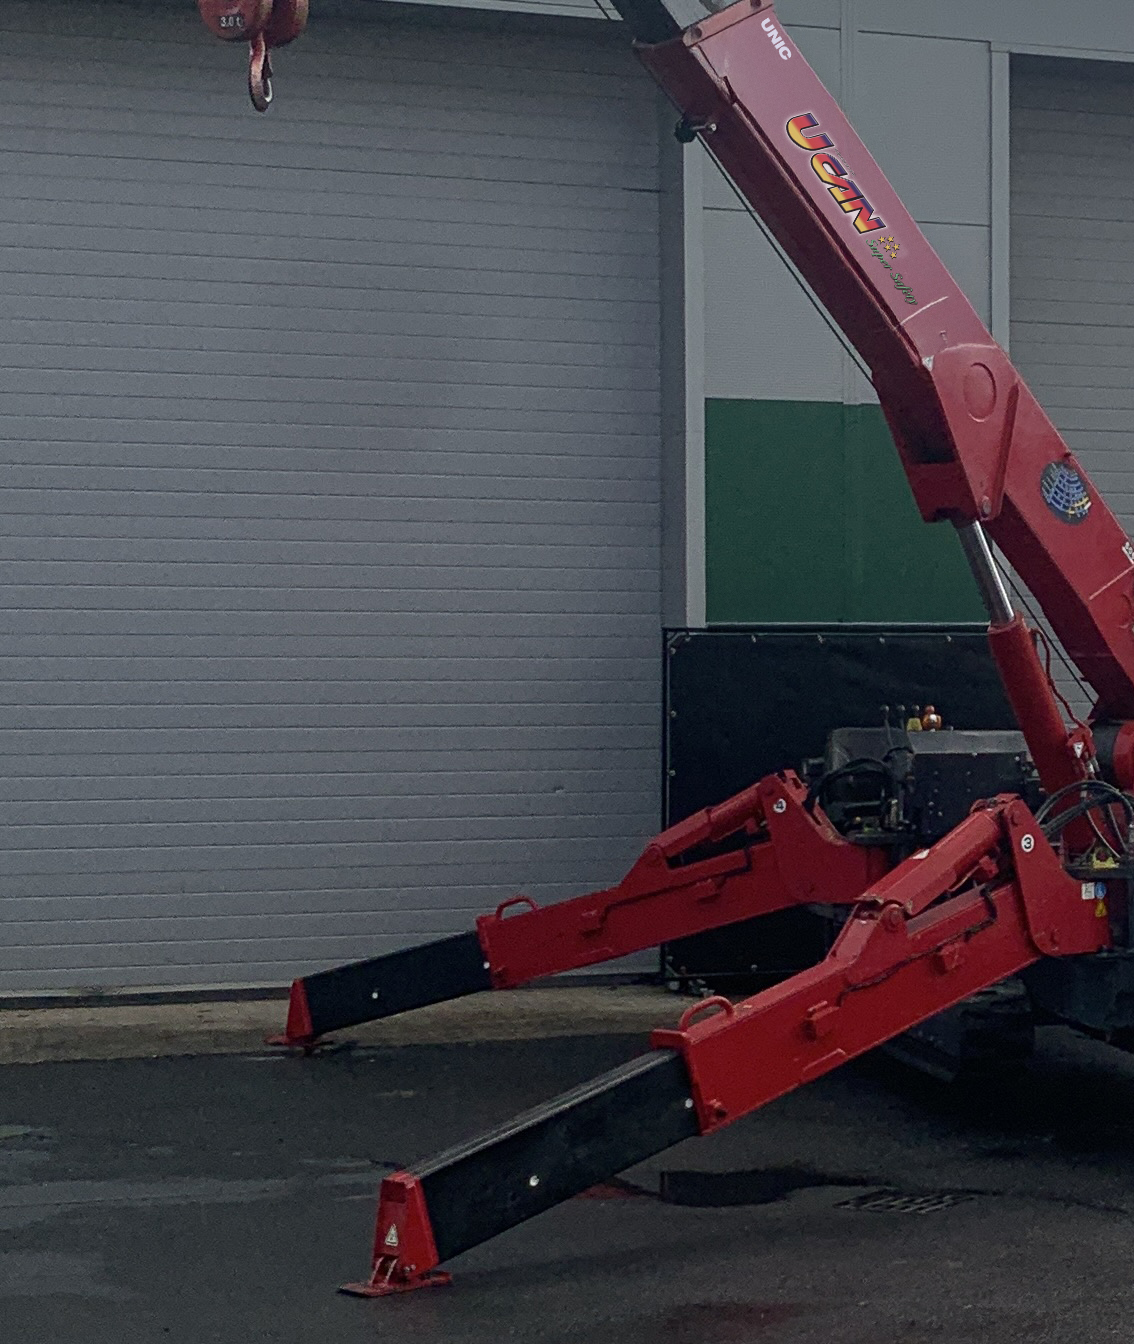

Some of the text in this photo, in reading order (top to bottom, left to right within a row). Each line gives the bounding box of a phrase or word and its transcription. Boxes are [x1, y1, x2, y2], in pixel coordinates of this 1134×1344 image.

[760, 18, 792, 60] UNIC
[866, 238, 918, 305] Super Safety
[1023, 836, 1032, 849] 3
